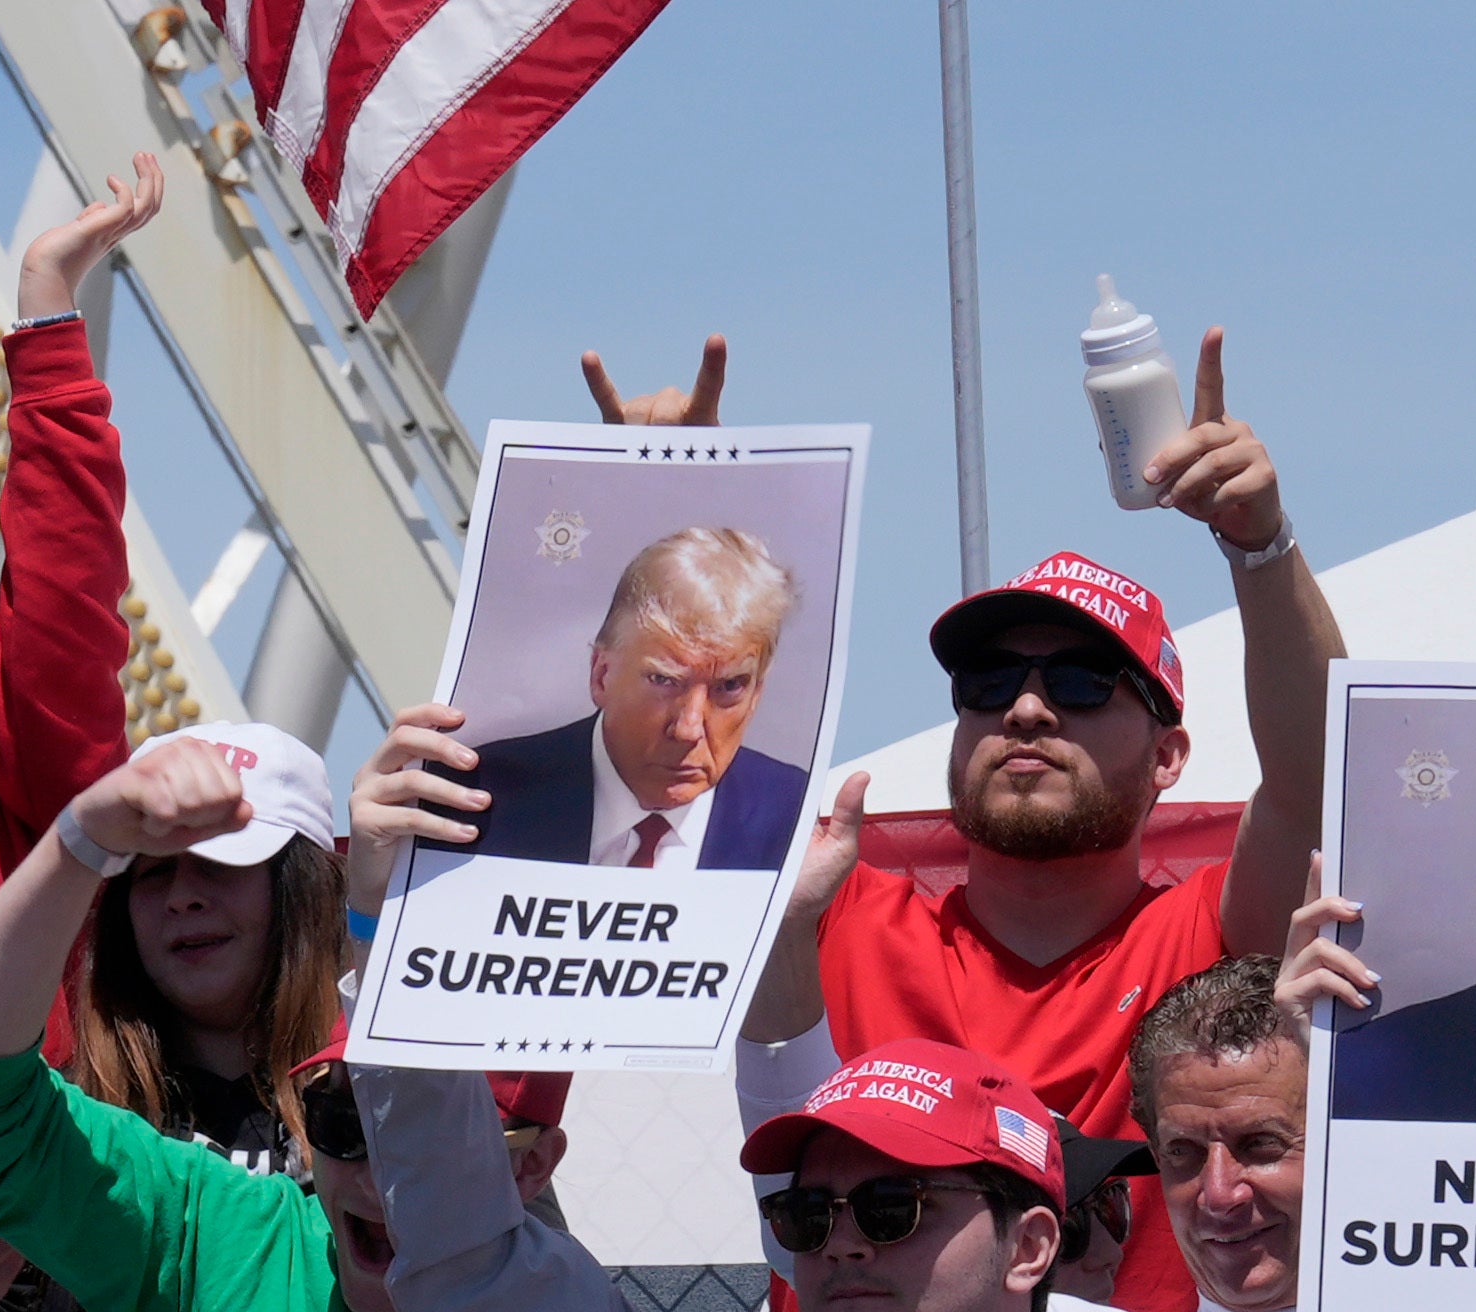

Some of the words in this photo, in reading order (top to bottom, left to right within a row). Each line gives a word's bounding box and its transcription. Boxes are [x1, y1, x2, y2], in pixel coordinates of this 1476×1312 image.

[1036, 559, 1149, 612] AMERICA
[493, 894, 679, 945] NEVER
[401, 947, 731, 1000] SURRENDER
[851, 1060, 954, 1100] AMERICA
[858, 1081, 939, 1115] AGAIN
